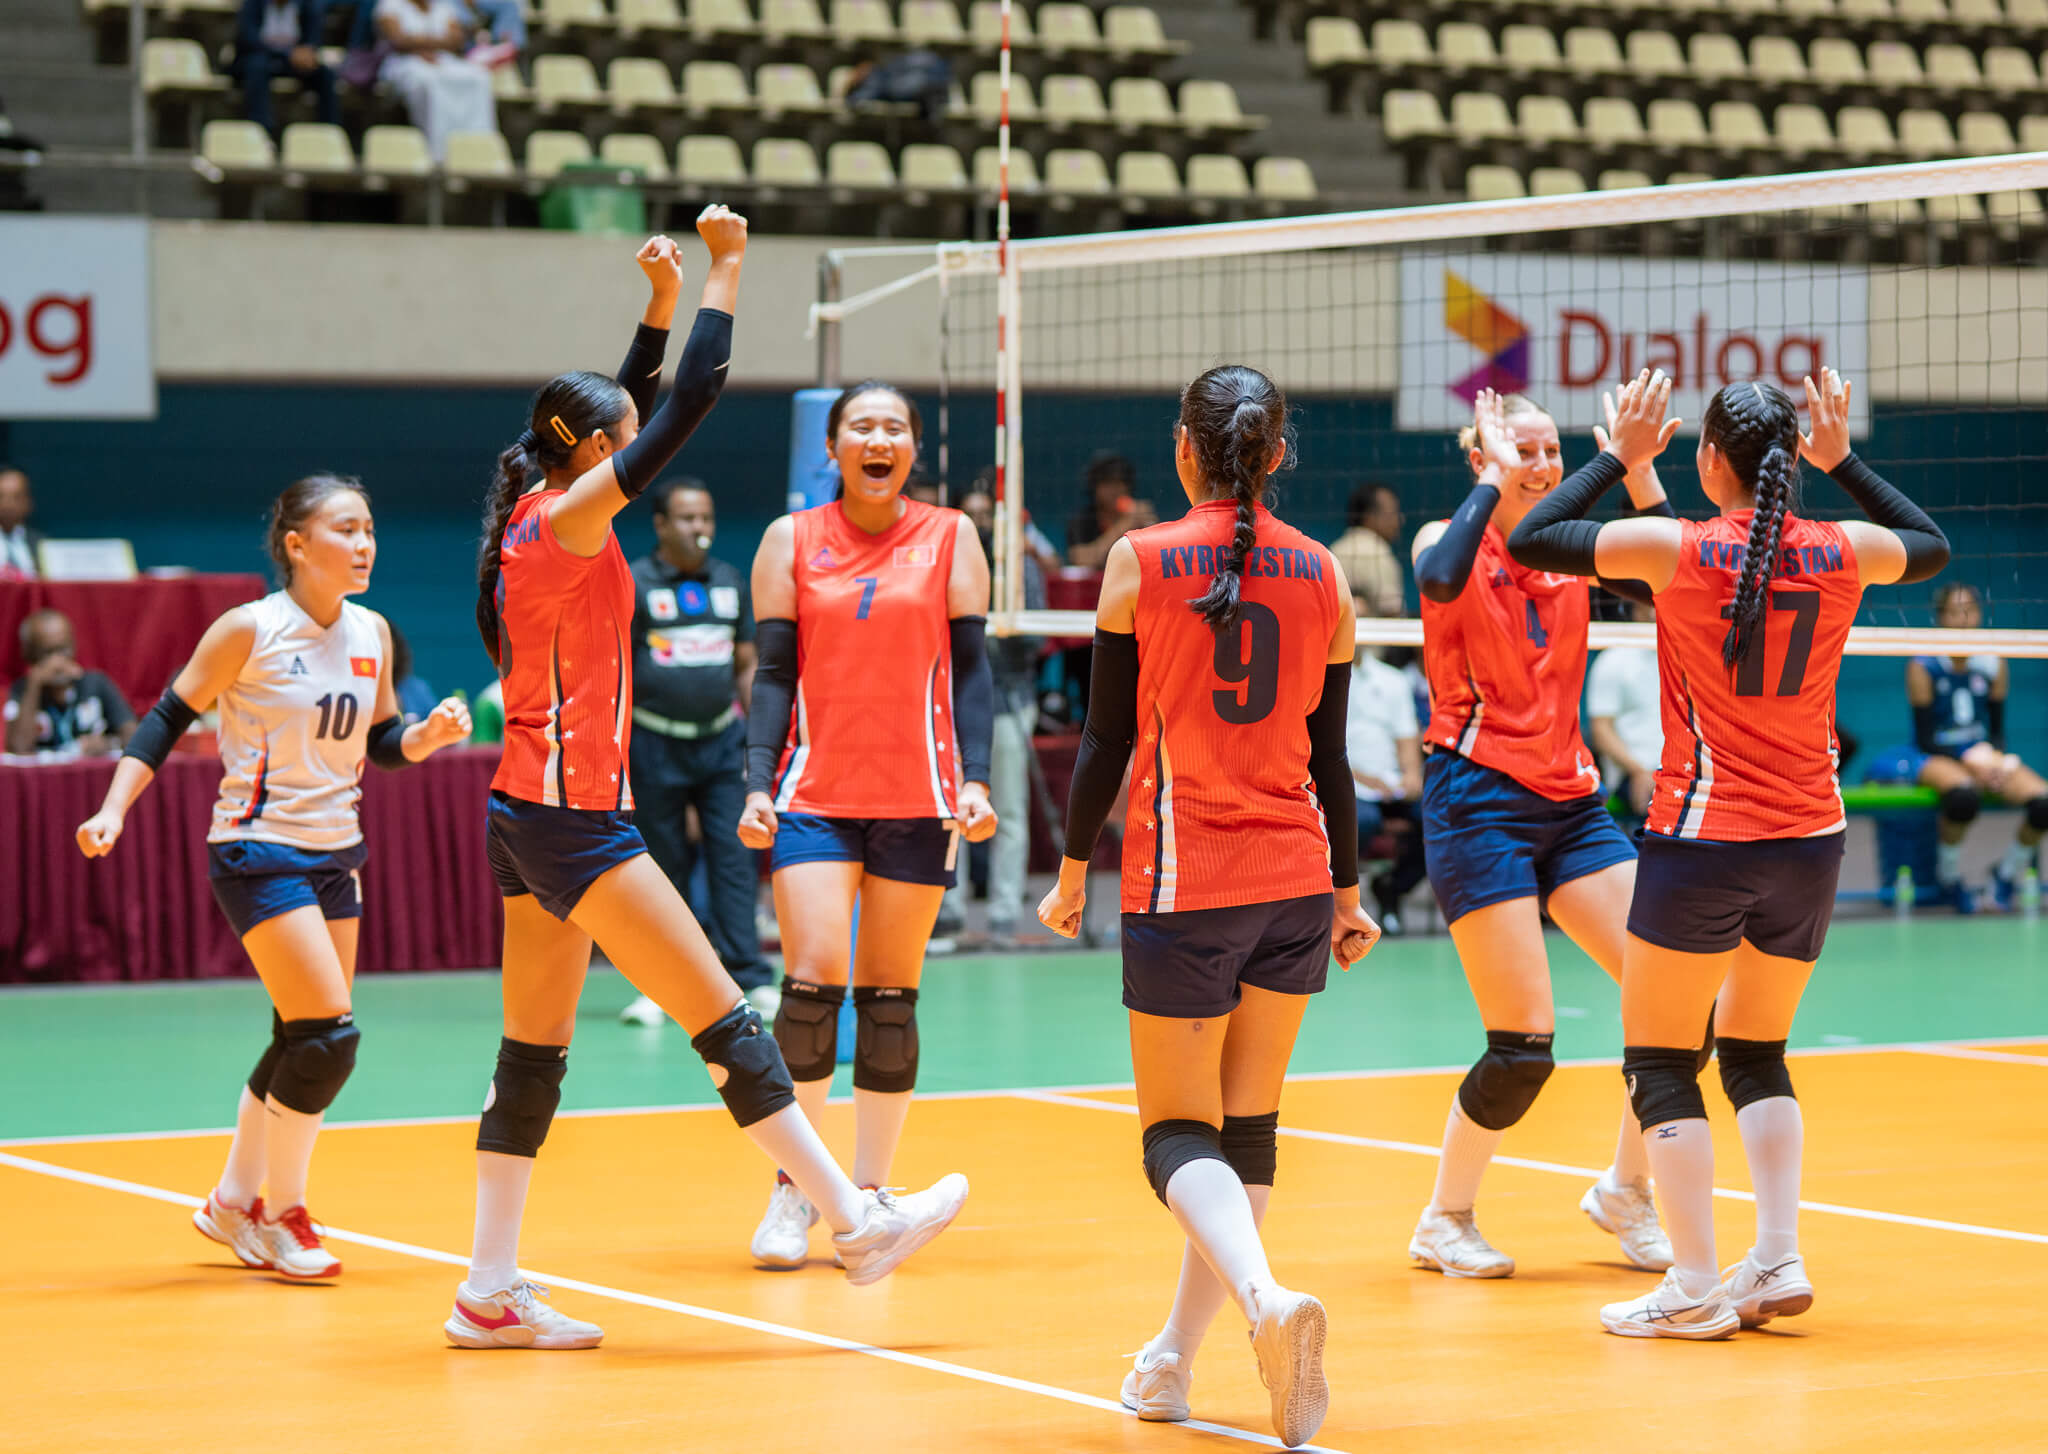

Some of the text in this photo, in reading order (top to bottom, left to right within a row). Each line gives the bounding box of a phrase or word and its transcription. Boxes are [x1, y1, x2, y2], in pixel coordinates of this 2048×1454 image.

[0, 293, 92, 385] g
[1558, 307, 1826, 412] Dialog
[1700, 540, 1844, 577] KYRZSTAN
[855, 577, 877, 620] 7
[1525, 598, 1548, 648] 4
[1212, 601, 1280, 724] 9
[1720, 591, 1820, 697] 17
[315, 693, 358, 740] 10
[942, 819, 960, 871] 7
